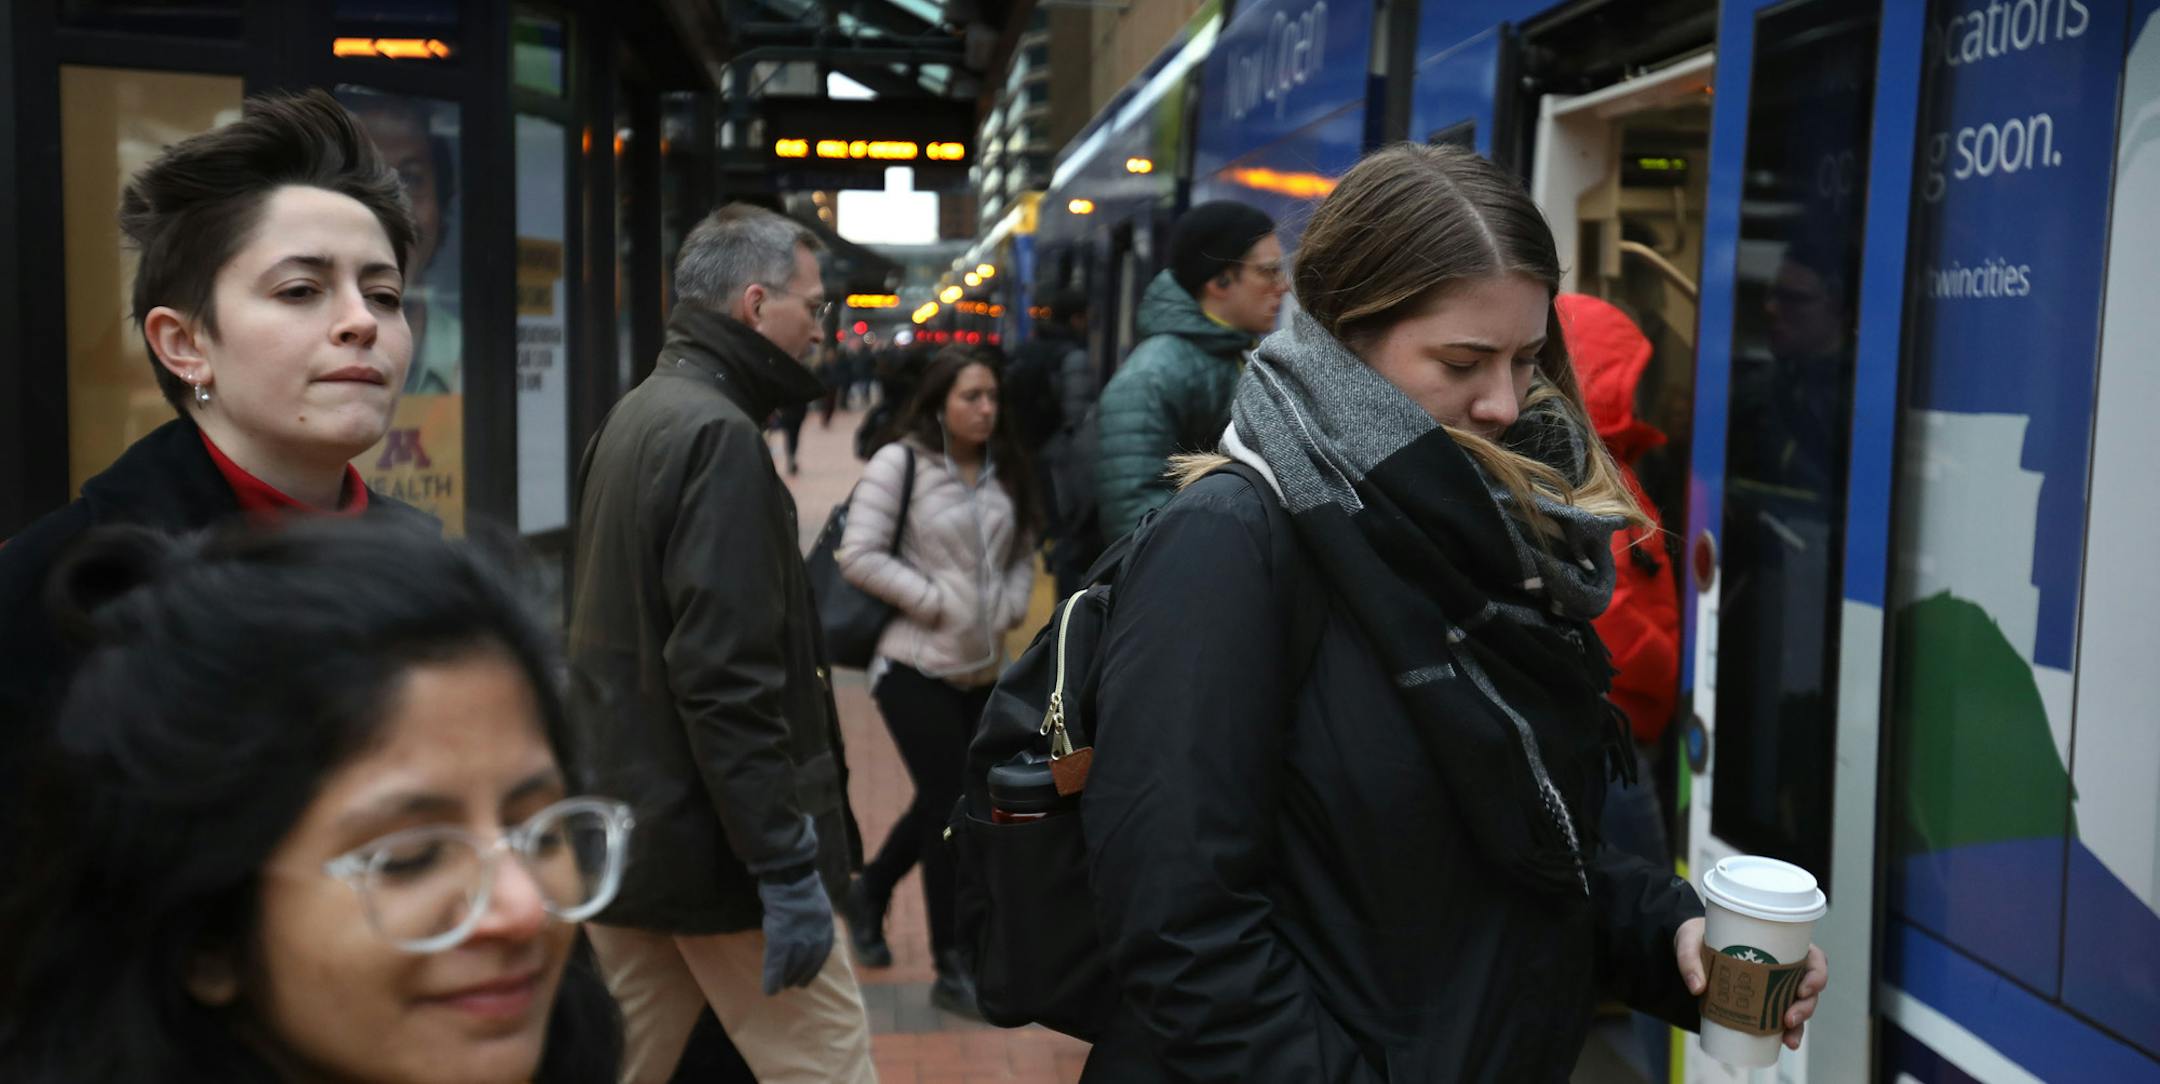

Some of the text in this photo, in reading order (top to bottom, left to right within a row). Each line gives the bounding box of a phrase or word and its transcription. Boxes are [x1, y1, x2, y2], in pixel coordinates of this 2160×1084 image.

[1265, 1, 1327, 120] Open
[1954, 112, 2062, 180] soon.
[376, 428, 432, 470] M
